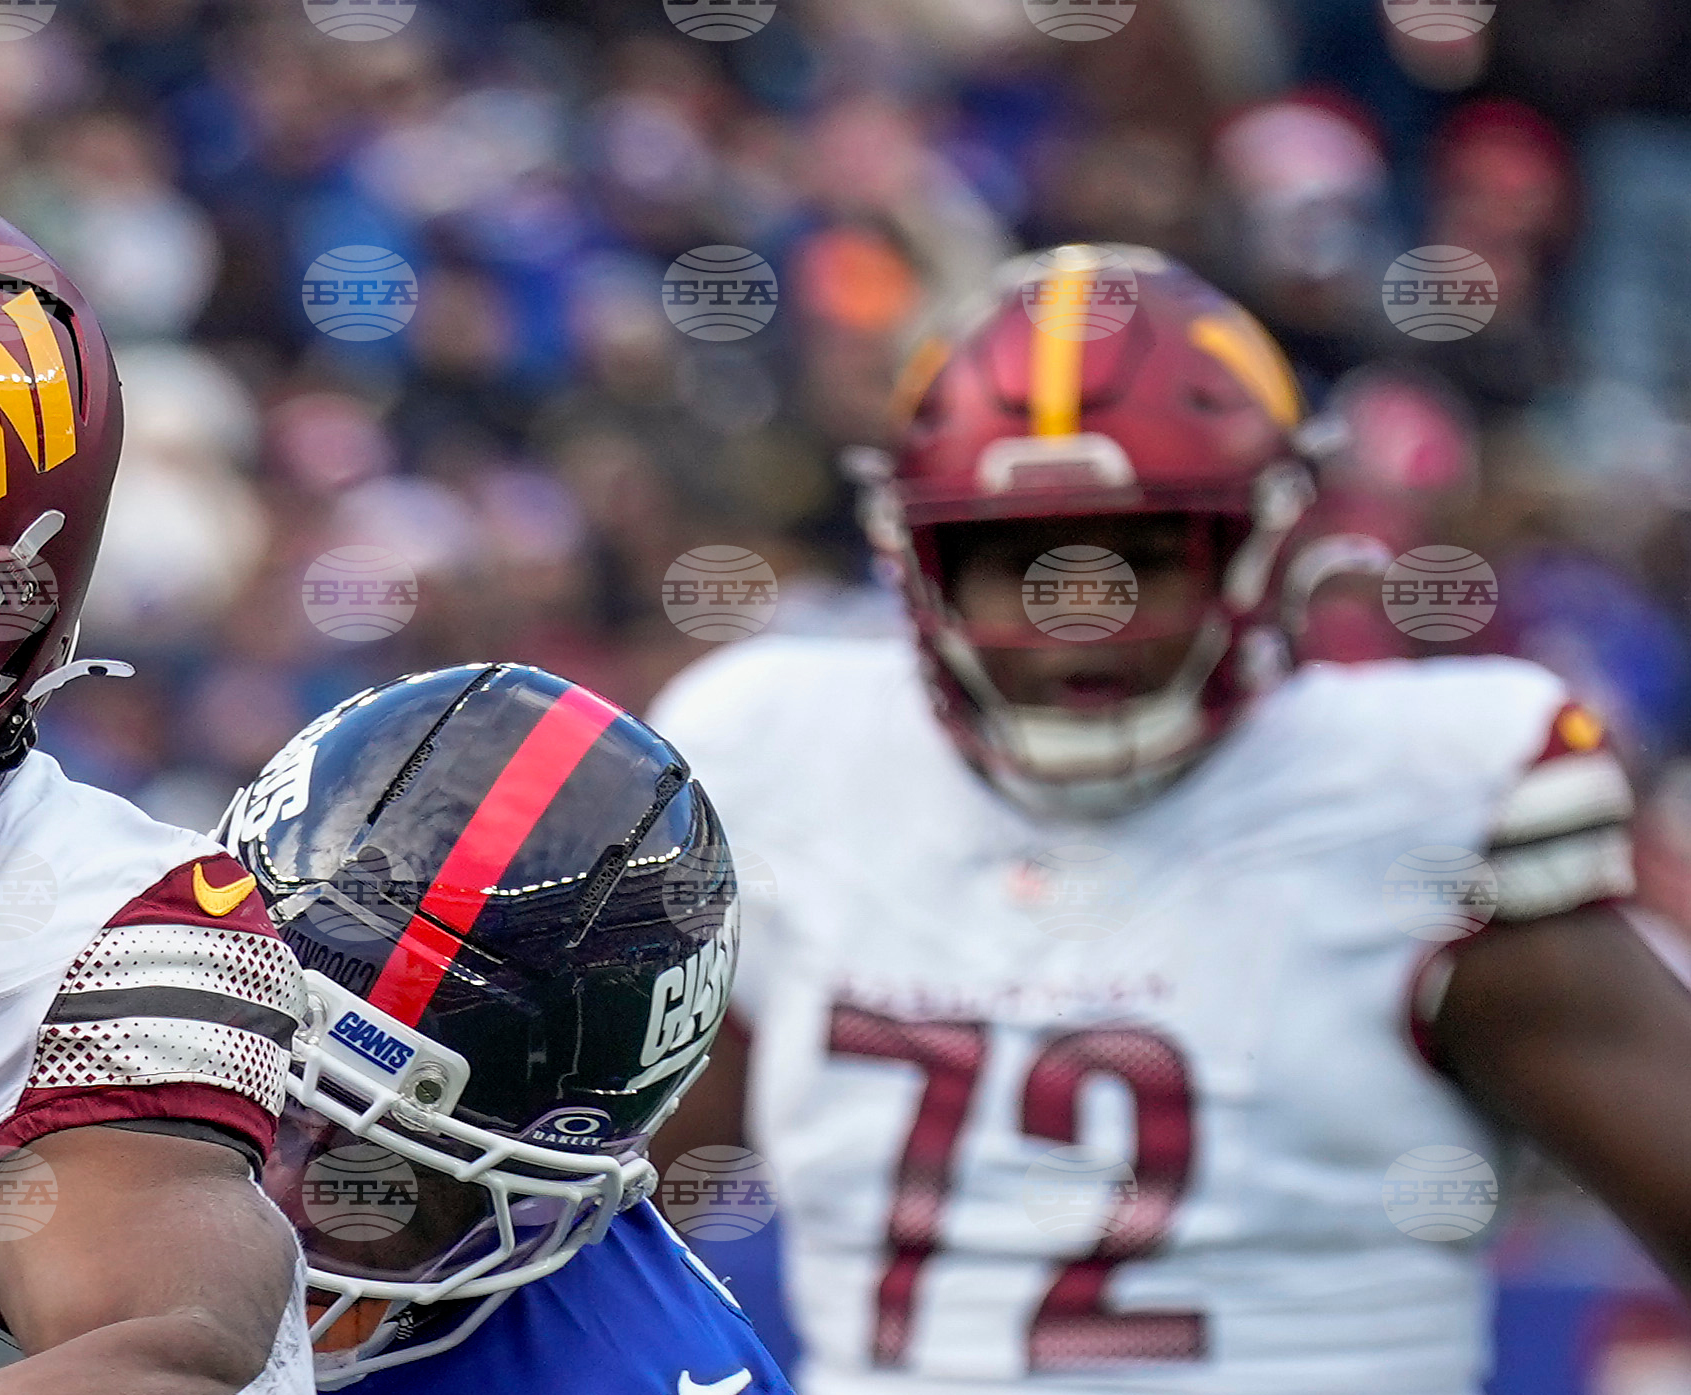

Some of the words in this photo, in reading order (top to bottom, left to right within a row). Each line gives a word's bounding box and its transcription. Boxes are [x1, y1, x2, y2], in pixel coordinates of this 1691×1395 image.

[334, 1010, 415, 1069] GIANTS
[532, 1129, 602, 1146] OAKLEY
[828, 1003, 1206, 1372] 72
